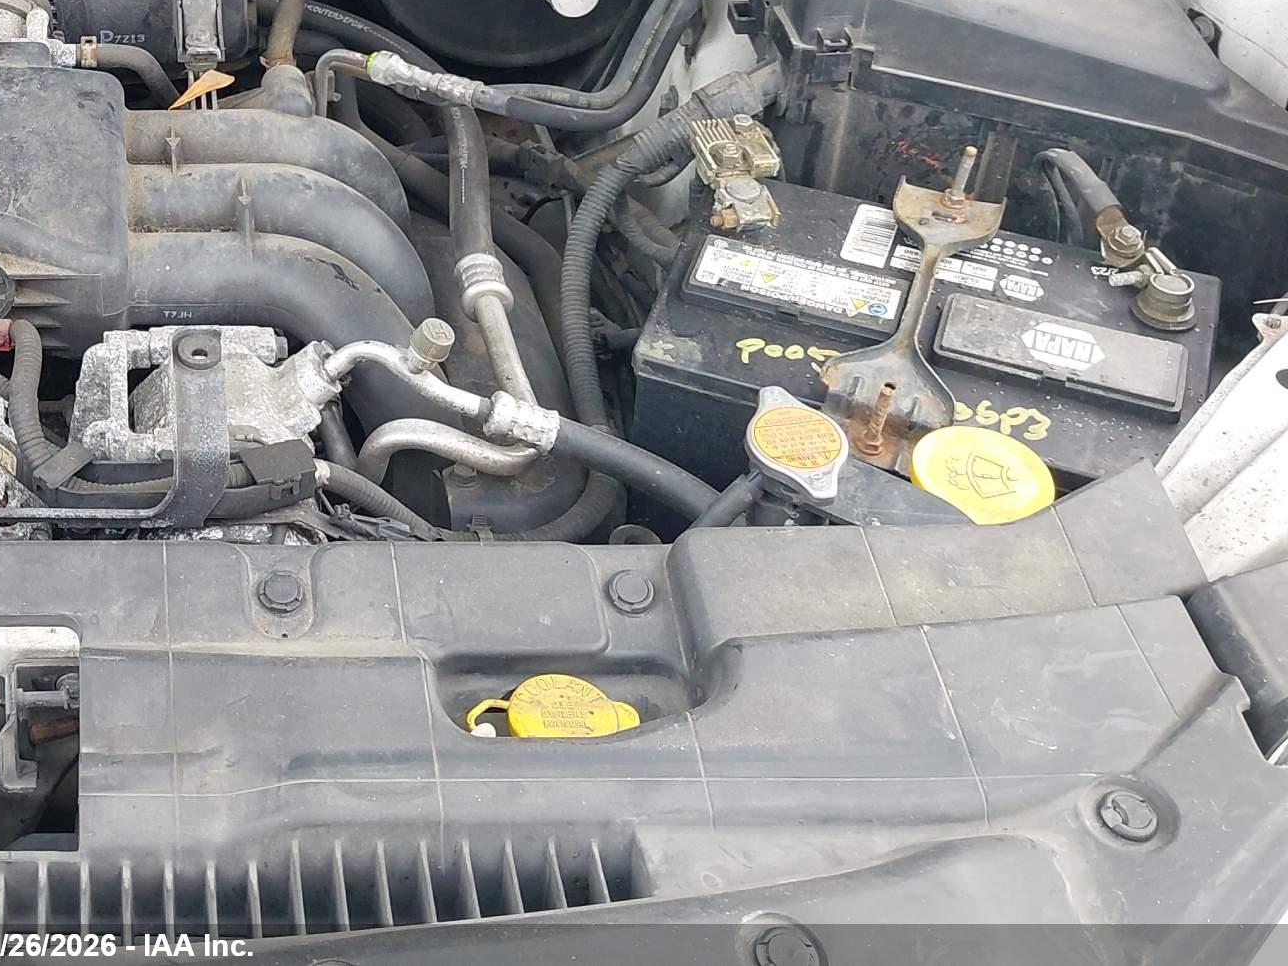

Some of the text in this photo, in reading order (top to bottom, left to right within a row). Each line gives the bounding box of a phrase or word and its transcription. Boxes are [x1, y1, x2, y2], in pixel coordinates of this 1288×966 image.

[1006, 280, 1037, 296] NAPA
[1034, 330, 1094, 363] NAPA
[514, 675, 604, 704] COOLANT
